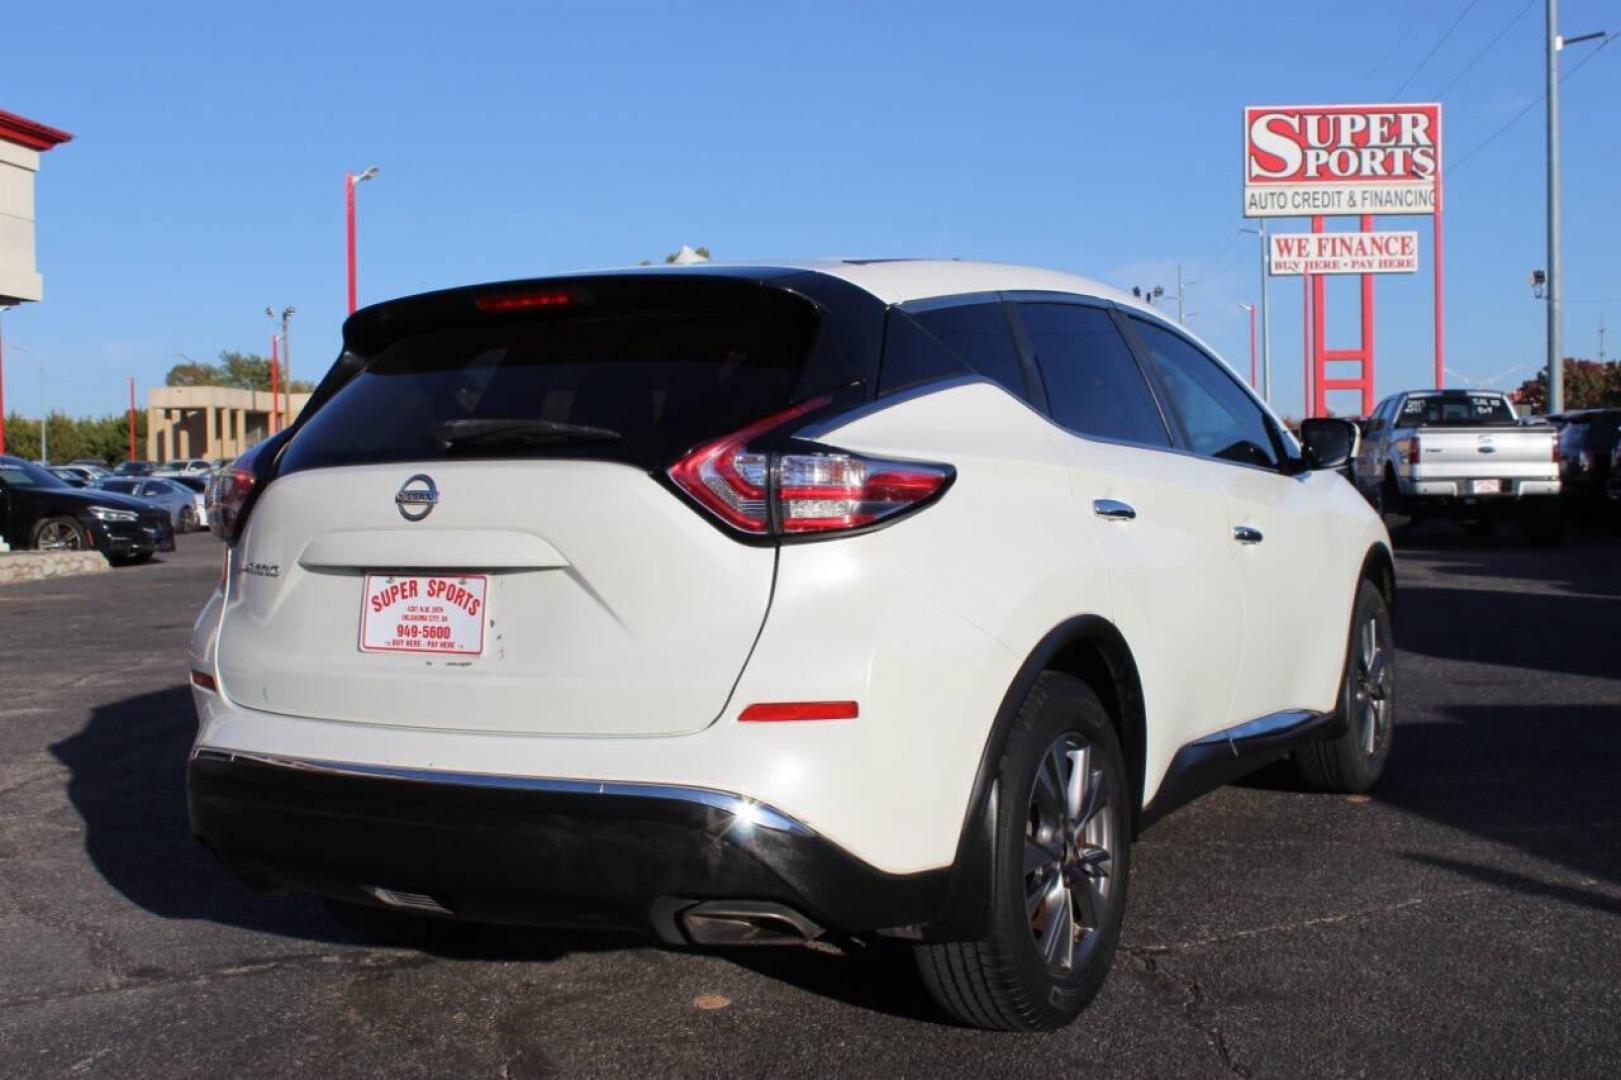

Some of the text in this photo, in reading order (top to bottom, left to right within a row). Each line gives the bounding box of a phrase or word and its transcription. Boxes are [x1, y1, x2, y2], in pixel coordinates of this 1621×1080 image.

[1250, 112, 1432, 179] SUPER
[1248, 191, 1287, 210] AUTO
[1291, 190, 1344, 209] CREDIT
[1347, 190, 1357, 208] &
[1274, 236, 1414, 258] WE FINANCE
[1304, 260, 1340, 270] HERE
[1351, 259, 1374, 270] PAY
[1378, 258, 1415, 269] HERE
[371, 579, 481, 616] SUPER SPORTS
[397, 624, 451, 639] 949-5600
